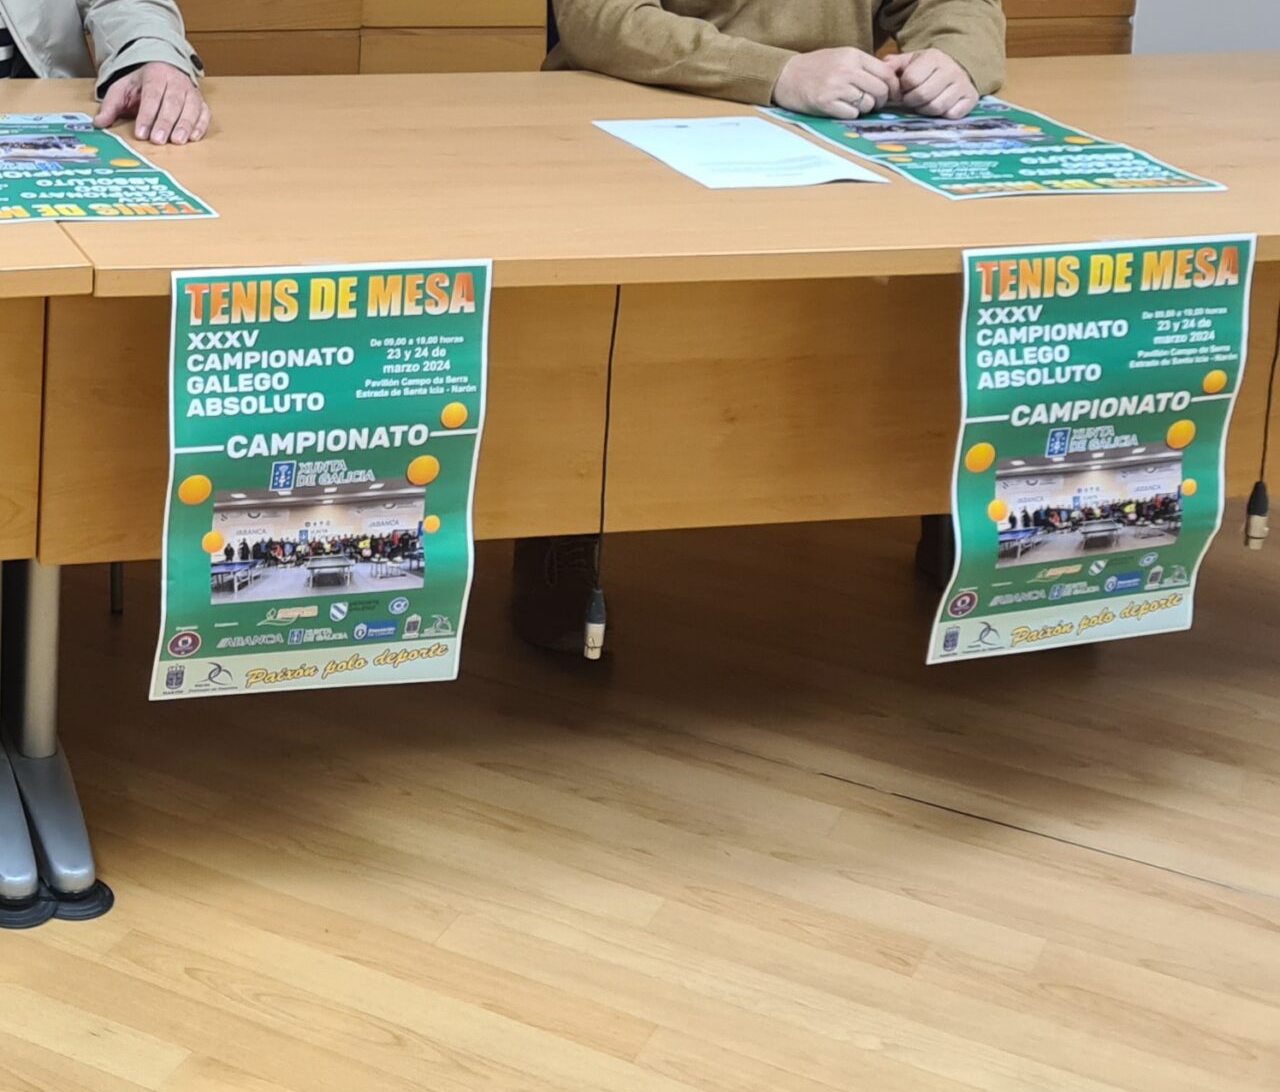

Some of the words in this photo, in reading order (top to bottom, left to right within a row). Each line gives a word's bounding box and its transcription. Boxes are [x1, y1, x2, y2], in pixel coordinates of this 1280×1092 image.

[975, 255, 1080, 302] TENIS
[1087, 253, 1134, 295] DE
[1140, 246, 1239, 292] MESA
[185, 279, 299, 326] TENIS
[309, 276, 358, 320] DE
[367, 272, 475, 317] MESA
[977, 305, 1043, 326] XXXV
[187, 329, 259, 351] XXXV
[976, 319, 1128, 346] CAMPIONATO
[186, 346, 354, 372] CAMPIONATO
[976, 344, 1070, 368] GALEGO
[186, 371, 289, 395] GALEGO
[977, 363, 1102, 391] ABSOLUTO
[186, 392, 325, 418] ABSOLUTO
[1010, 390, 1191, 427] CAMPIONATO
[226, 424, 429, 459] CAMPIONATO
[1070, 439, 1088, 453] DE
[1088, 434, 1139, 451] GALICIA
[1071, 425, 1115, 440] XUNTA
[297, 472, 317, 486] DE
[318, 469, 376, 484] GALICIA
[298, 459, 348, 473] XUNTA
[1010, 621, 1074, 647] Paixón
[1078, 607, 1115, 631] polo
[1119, 593, 1184, 621] deporte
[245, 660, 318, 689] Paixón
[321, 654, 367, 678] polo
[372, 642, 449, 669] deporte
